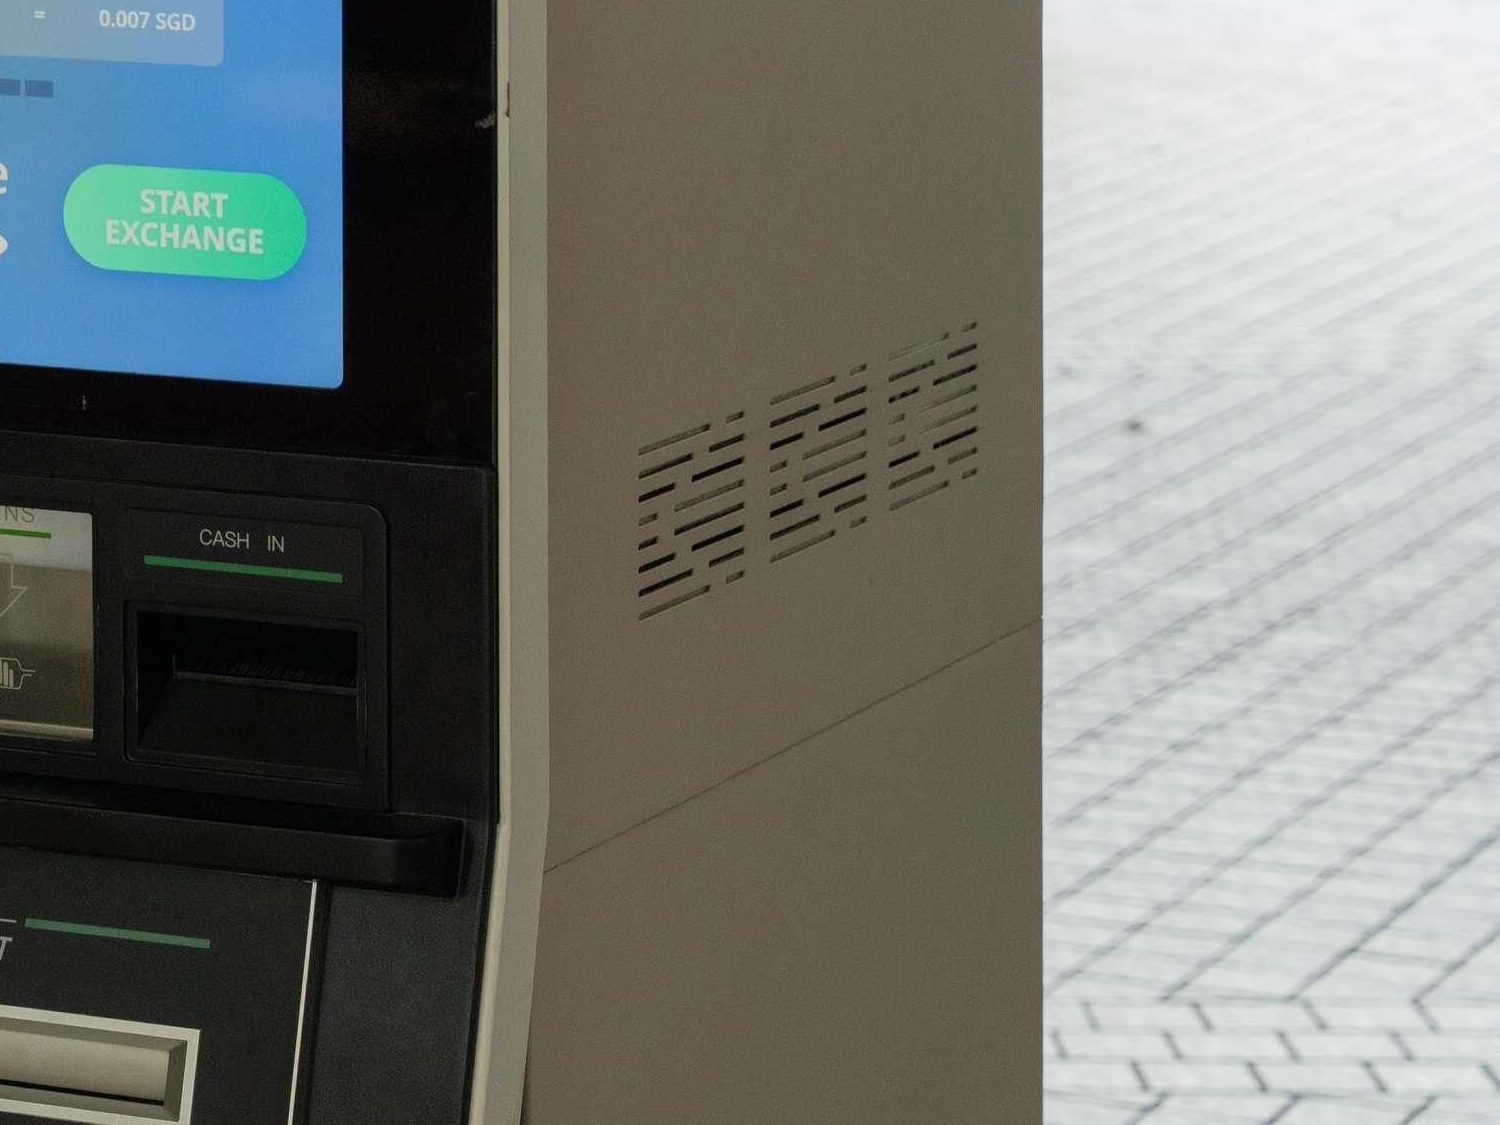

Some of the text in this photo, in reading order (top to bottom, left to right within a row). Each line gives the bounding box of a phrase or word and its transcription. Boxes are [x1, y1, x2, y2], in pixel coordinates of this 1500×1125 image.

[99, 9, 150, 29] 0.007
[156, 12, 196, 31] SGD
[140, 188, 227, 218] START
[105, 219, 264, 255] EXCHANGE
[199, 528, 286, 553] CASH IN
